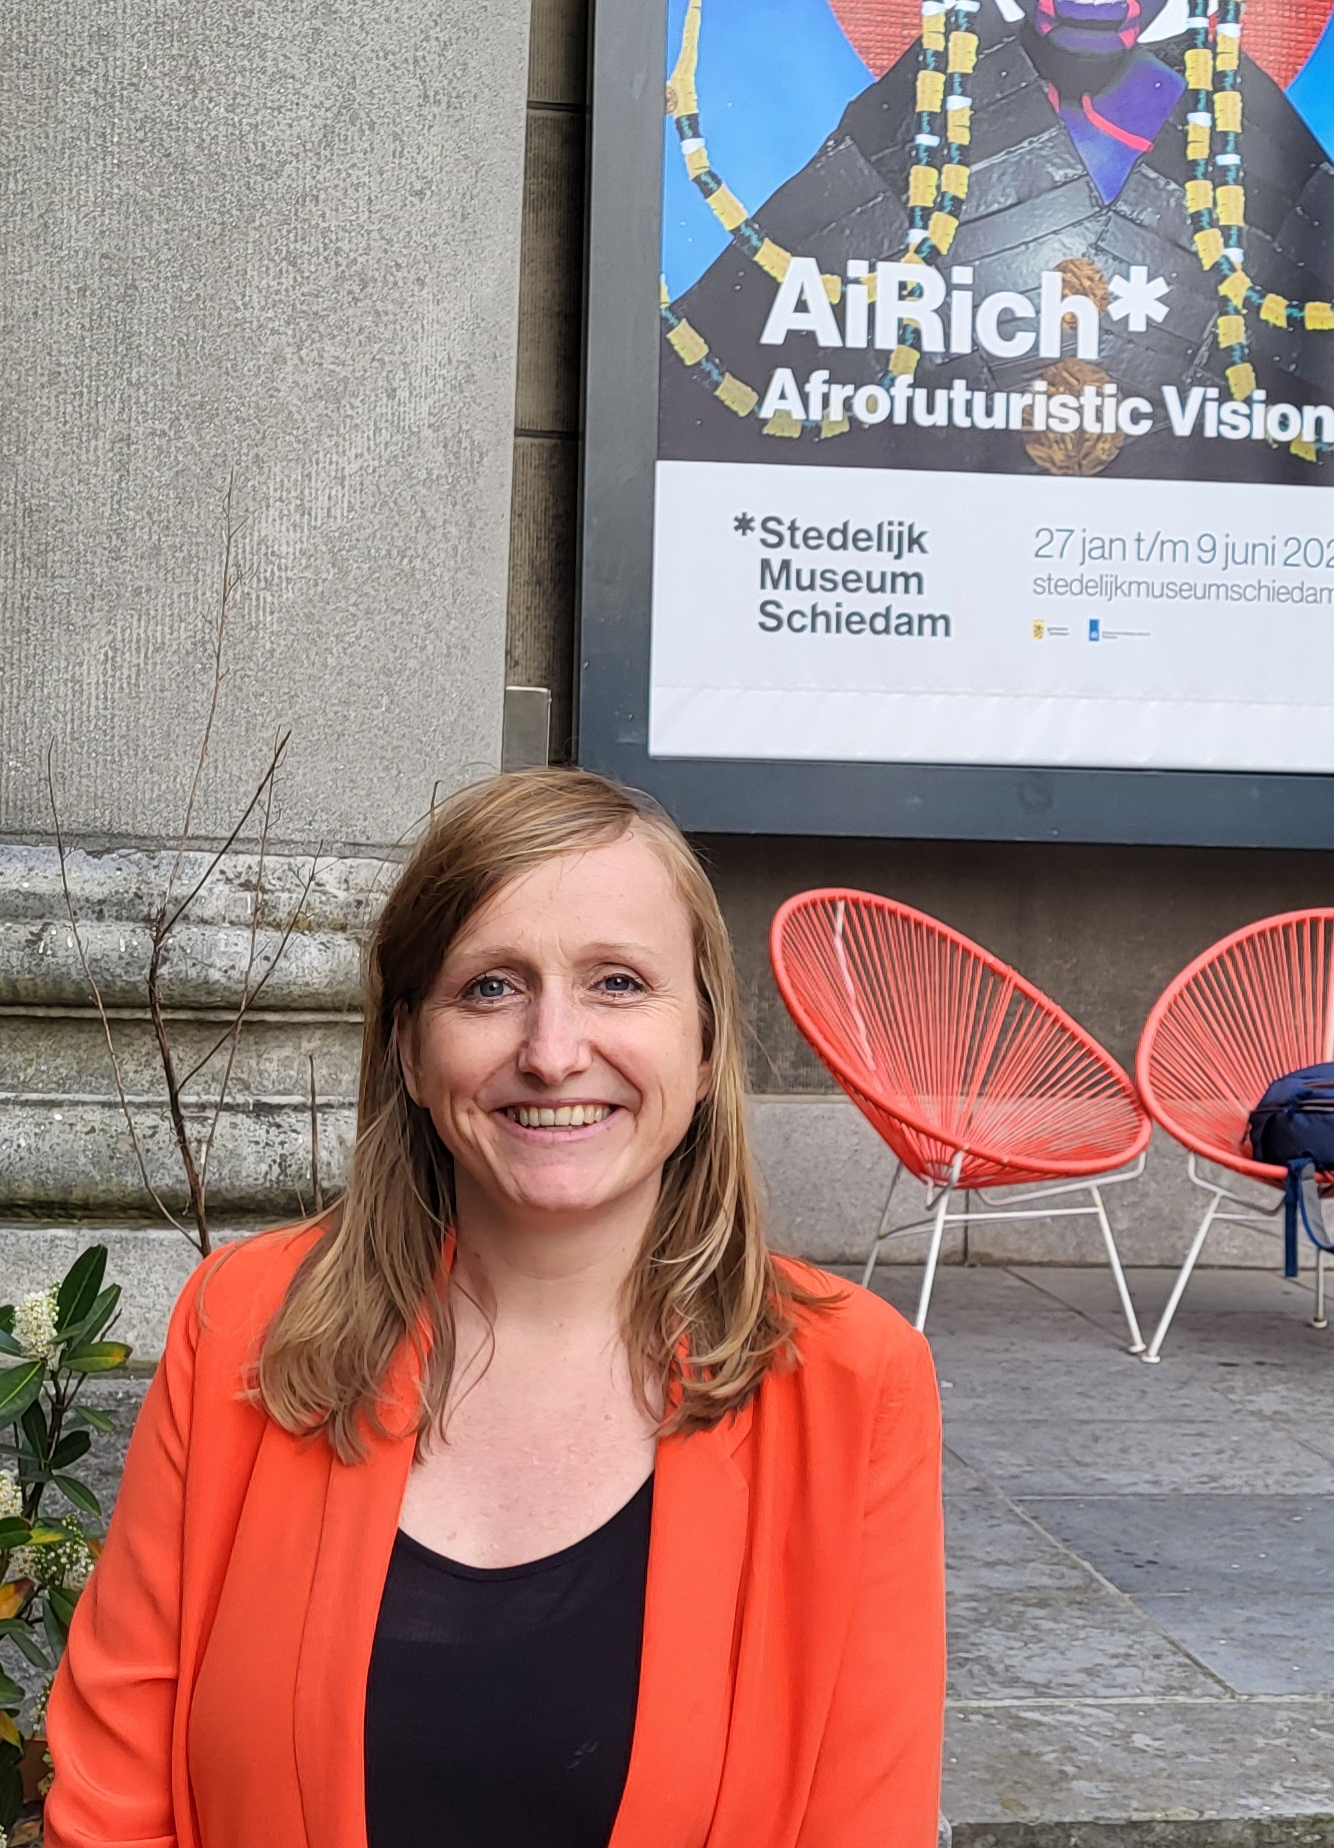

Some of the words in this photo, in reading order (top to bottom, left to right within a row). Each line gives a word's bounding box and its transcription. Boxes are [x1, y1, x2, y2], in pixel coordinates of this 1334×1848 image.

[758, 367, 1154, 437] Afrofuturistic
[1033, 527, 1075, 559] 27
[1079, 527, 1128, 567] jan
[1134, 531, 1190, 564] t/m
[1196, 533, 1218, 565] 9
[1221, 533, 1277, 572] juni
[759, 558, 925, 596] Museum
[758, 599, 952, 638] Schiedam
